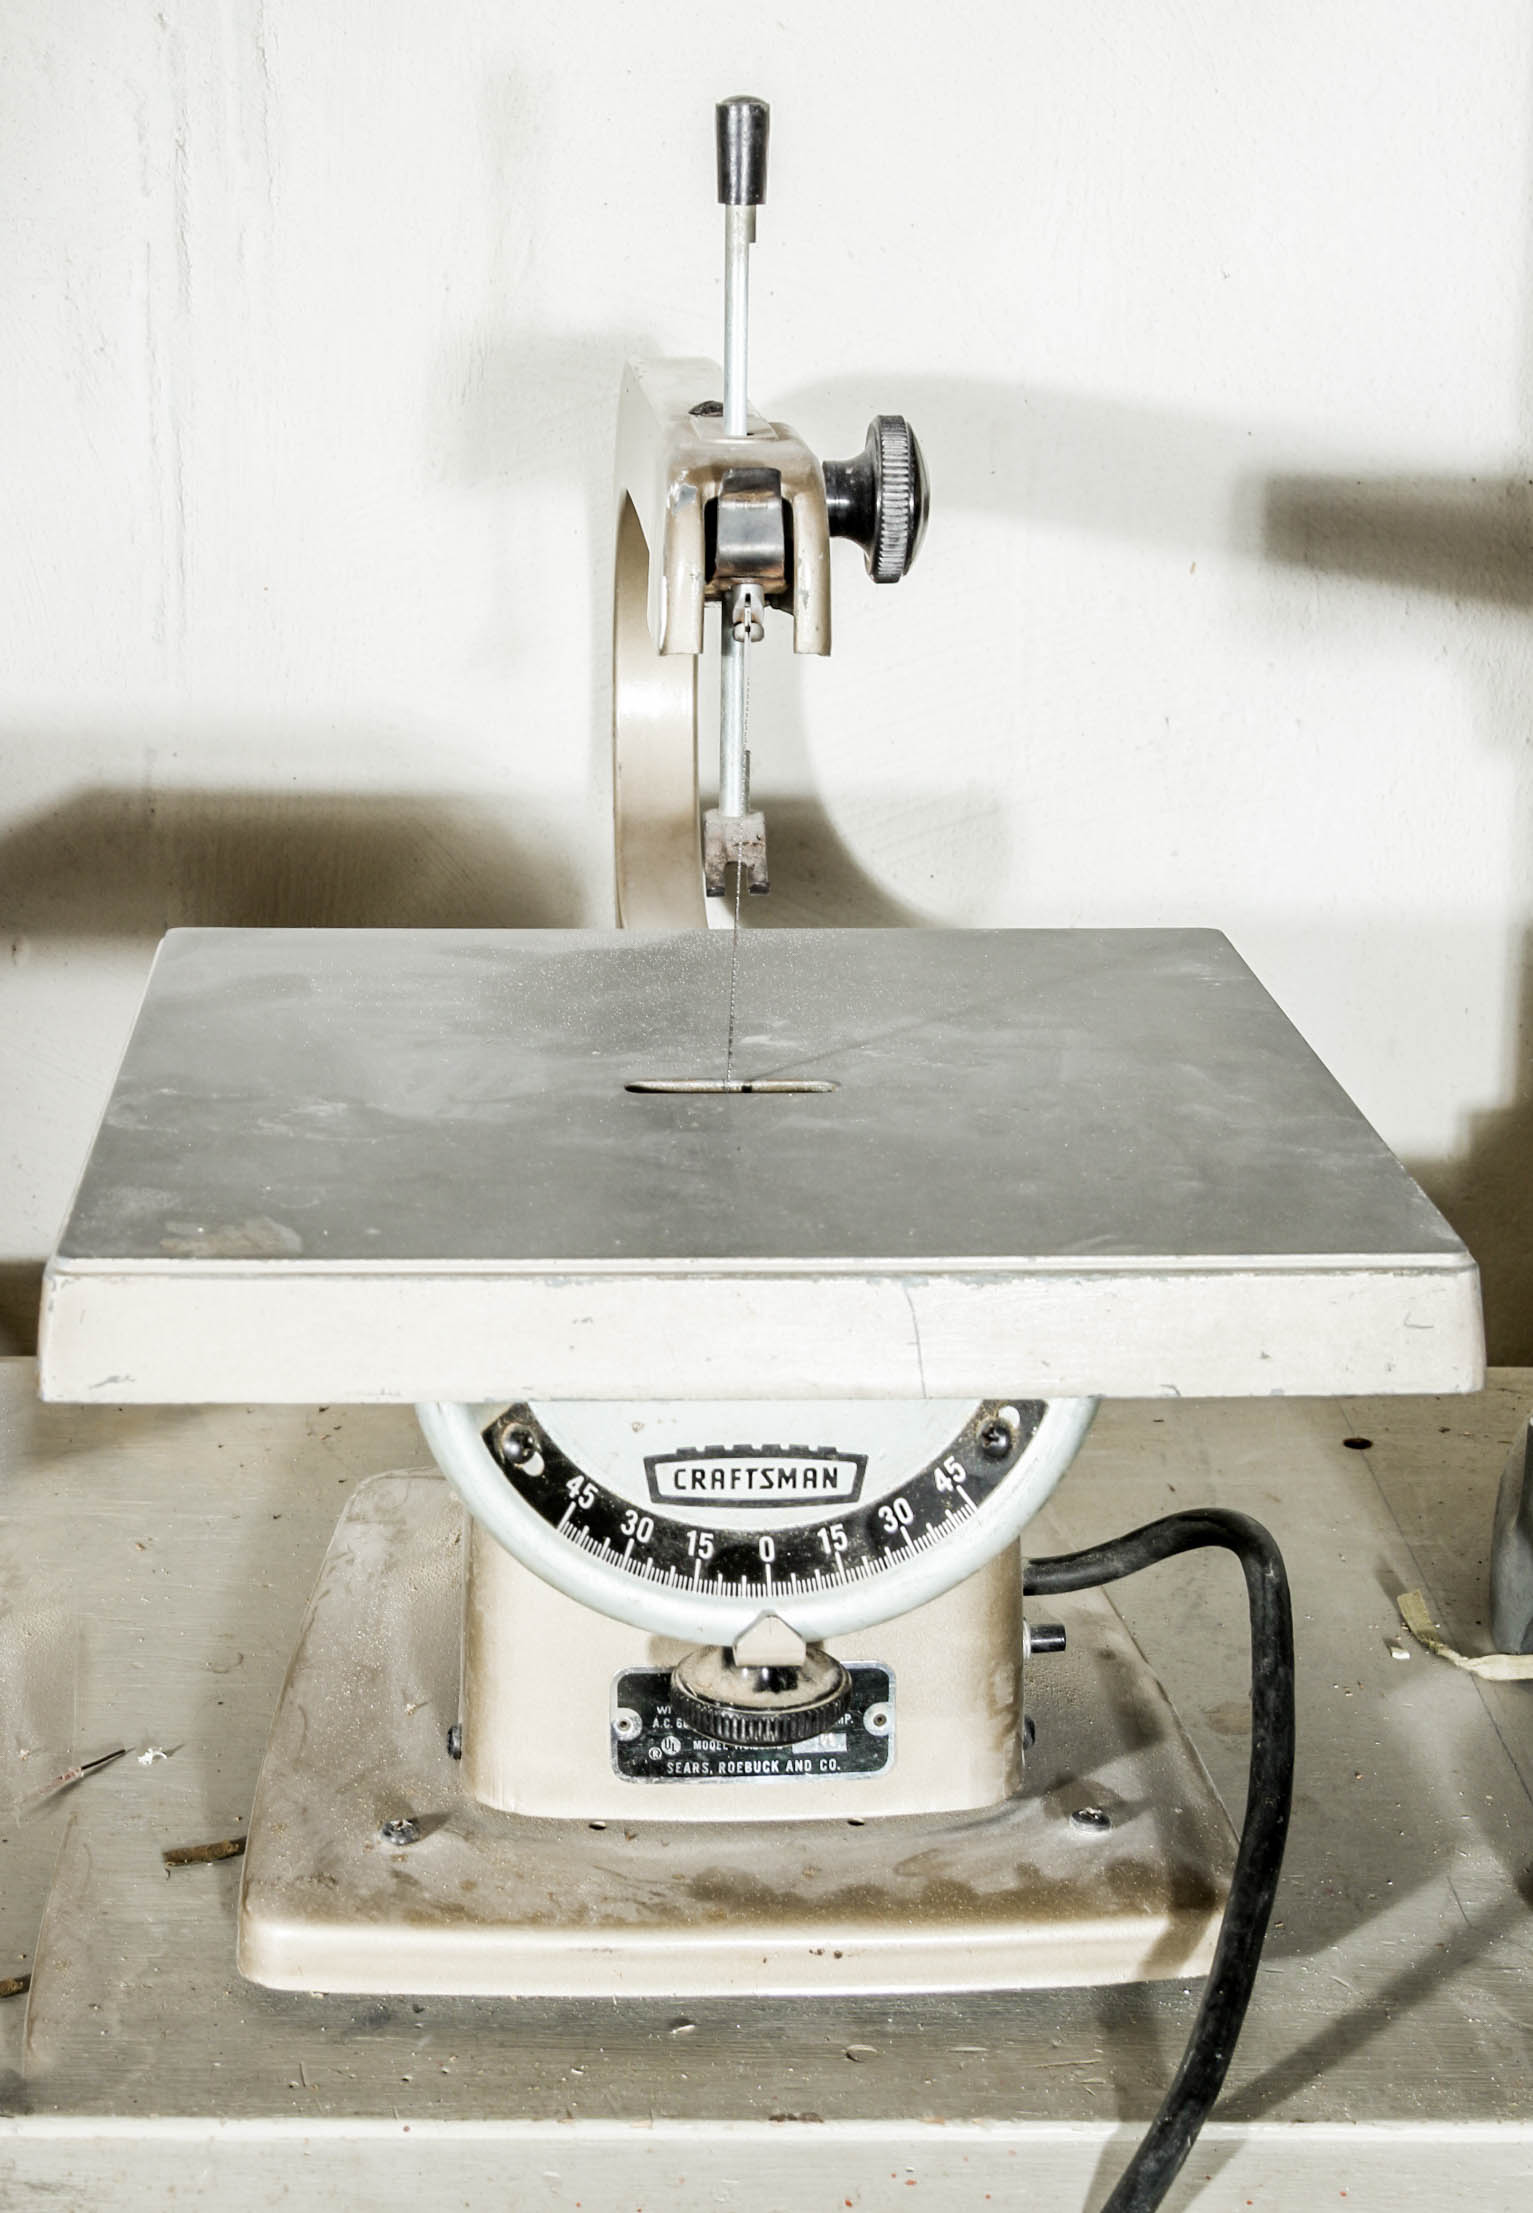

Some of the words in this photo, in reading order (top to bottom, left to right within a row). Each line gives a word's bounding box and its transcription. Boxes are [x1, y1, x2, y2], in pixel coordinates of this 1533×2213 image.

[674, 1467, 838, 1490] CRAFTSMAN
[934, 1456, 967, 1492] 45
[566, 1475, 598, 1509] 45
[621, 1510, 654, 1543] 30
[878, 1497, 914, 1533] 30
[687, 1530, 714, 1559] 15
[758, 1535, 776, 1563] 0
[816, 1523, 849, 1555] 15
[718, 1760, 780, 1774] ROEBUCK
[785, 1759, 812, 1773] AND
[819, 1757, 841, 1771] CO.
